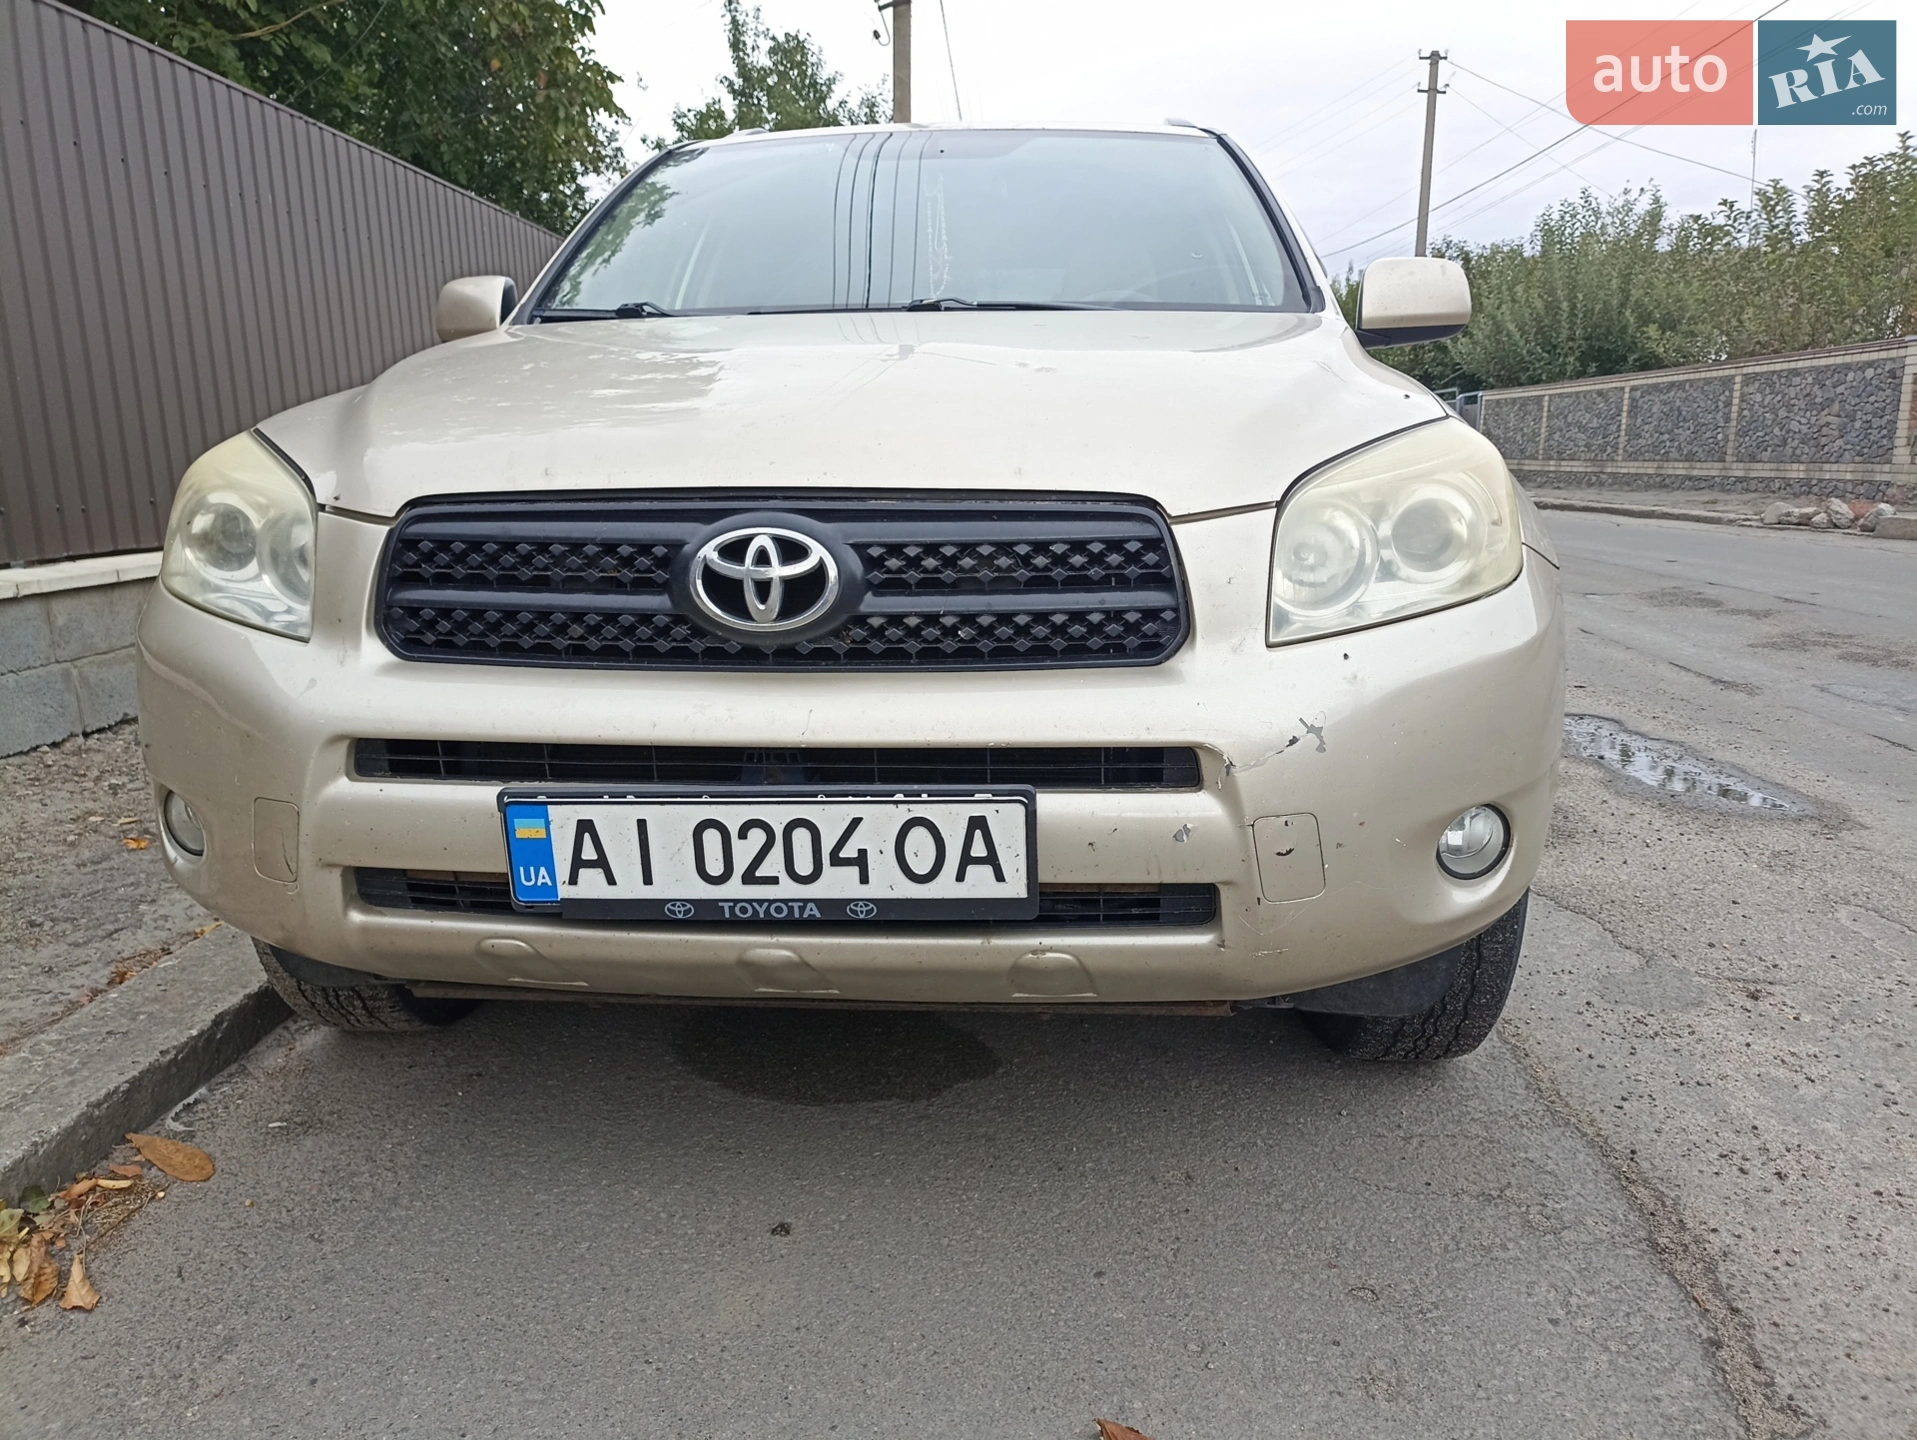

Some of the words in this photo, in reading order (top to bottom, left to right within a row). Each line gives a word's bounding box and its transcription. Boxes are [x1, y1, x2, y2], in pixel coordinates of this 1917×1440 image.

[567, 818, 654, 886] AI
[692, 817, 870, 885] 0204
[894, 815, 1006, 884] OA
[519, 866, 552, 887] UA
[718, 902, 821, 919] TOYOTA
